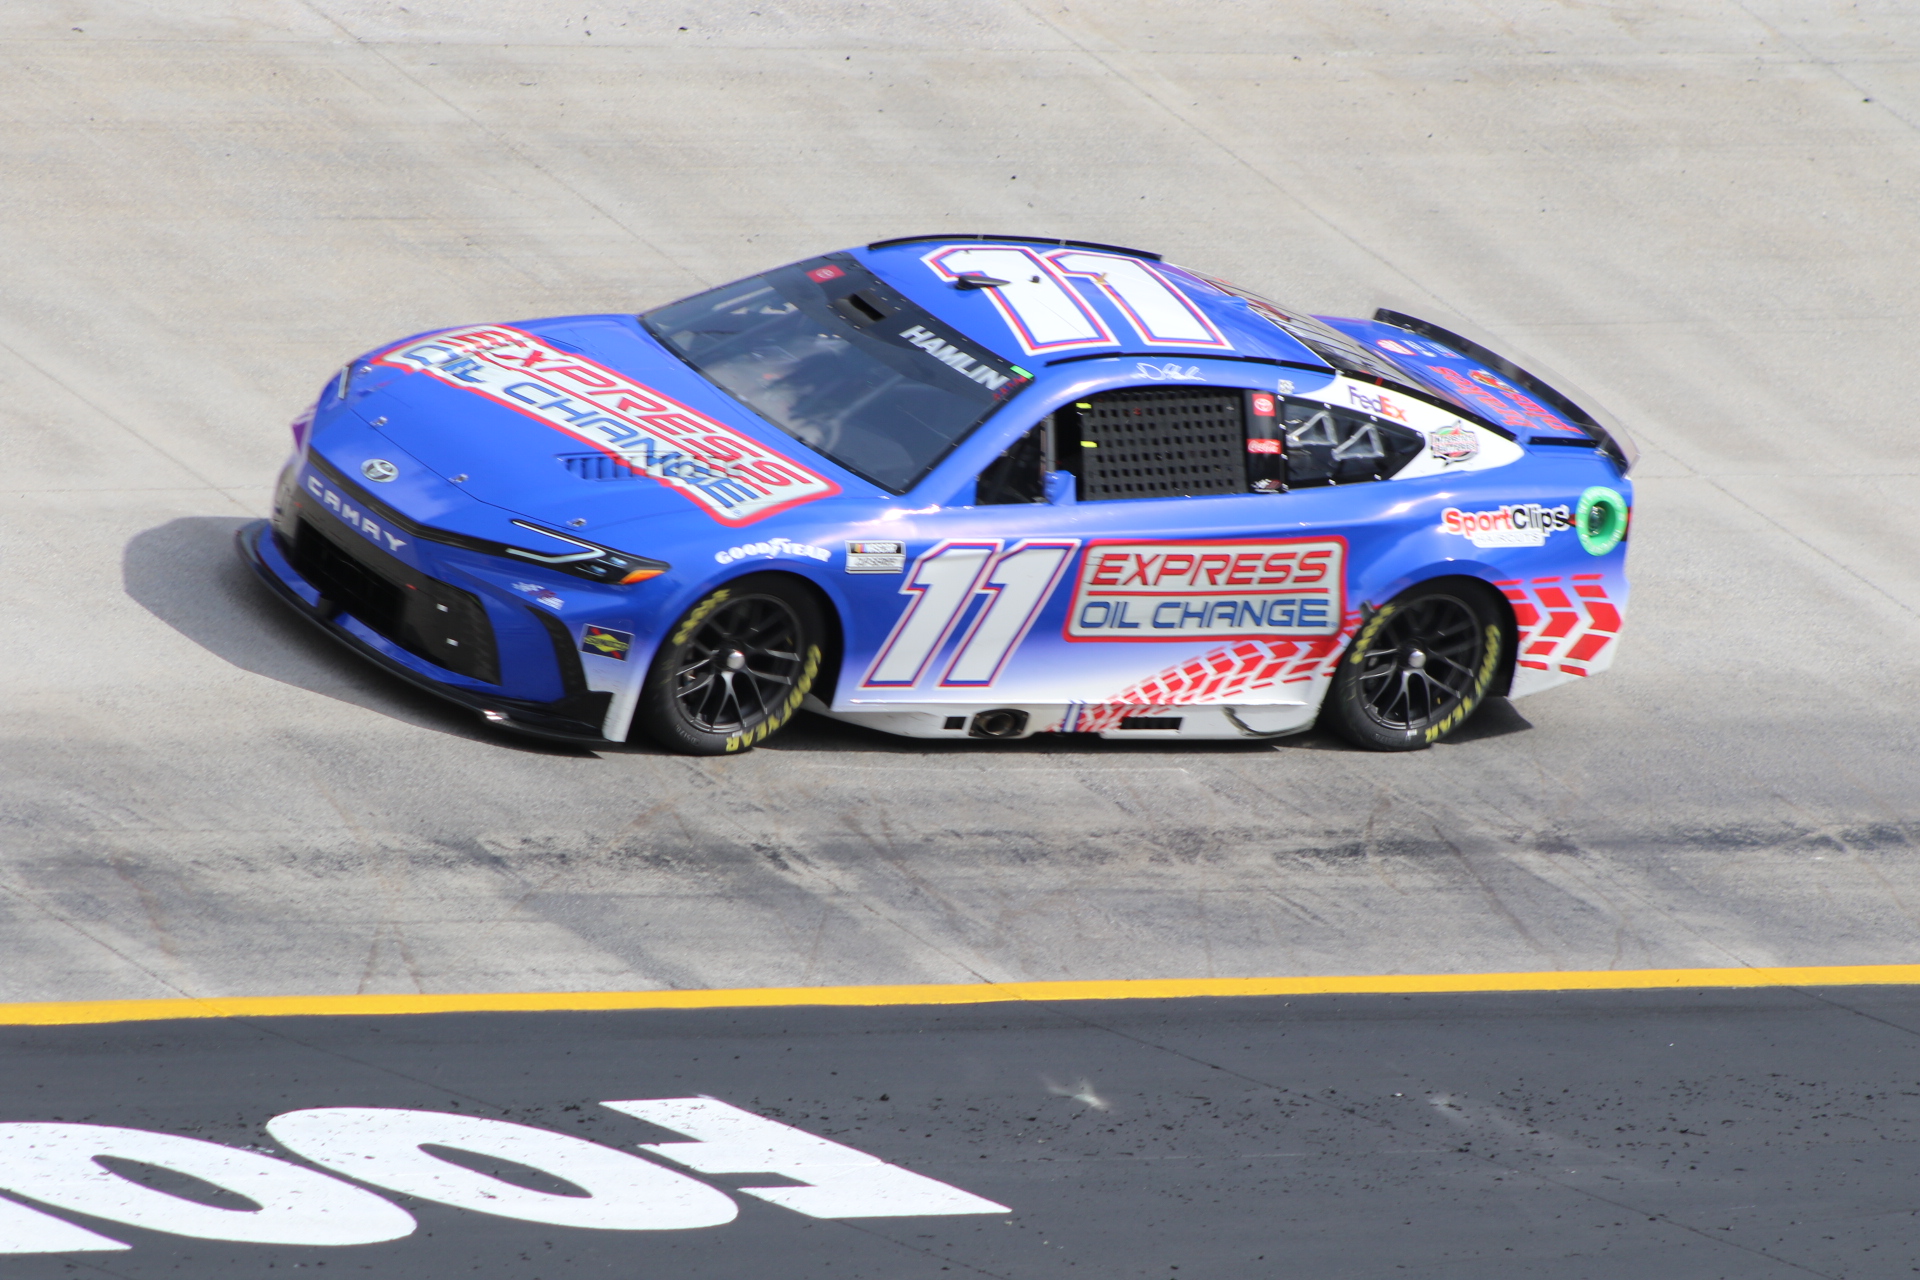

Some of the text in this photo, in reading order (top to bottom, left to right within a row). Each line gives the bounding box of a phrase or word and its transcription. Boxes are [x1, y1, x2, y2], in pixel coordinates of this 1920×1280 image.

[920, 245, 1235, 356] 11
[899, 324, 1011, 391] HAMLIN
[437, 330, 813, 495] EXPRESS
[1347, 384, 1408, 423] FedEx
[504, 381, 761, 509] CHANGE
[307, 475, 408, 552] CAMRY
[1090, 550, 1333, 586] EXPRESS
[856, 538, 1082, 690] 11
[1080, 598, 1329, 629] OIL CHANGE
